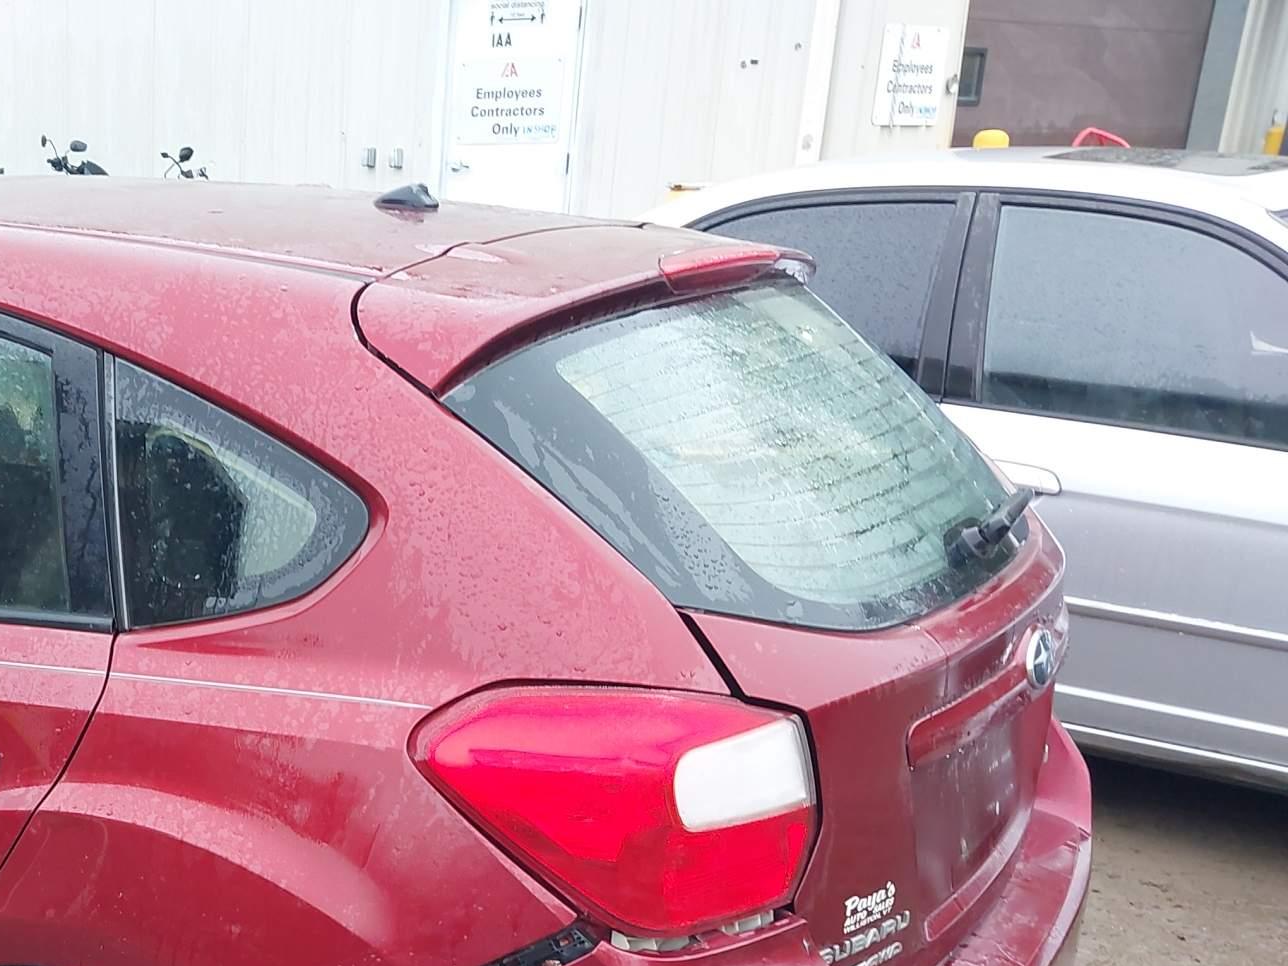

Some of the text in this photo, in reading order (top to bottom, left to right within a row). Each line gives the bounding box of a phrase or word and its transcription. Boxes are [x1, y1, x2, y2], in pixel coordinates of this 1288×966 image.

[491, 32, 512, 48] IAA
[892, 59, 933, 77] Employees
[476, 87, 543, 101] Employees
[887, 80, 933, 94] Contractors
[471, 105, 545, 117] Contractors
[492, 123, 520, 137] Only
[844, 910, 868, 928] AUTO
[819, 910, 910, 965] SUBARU
